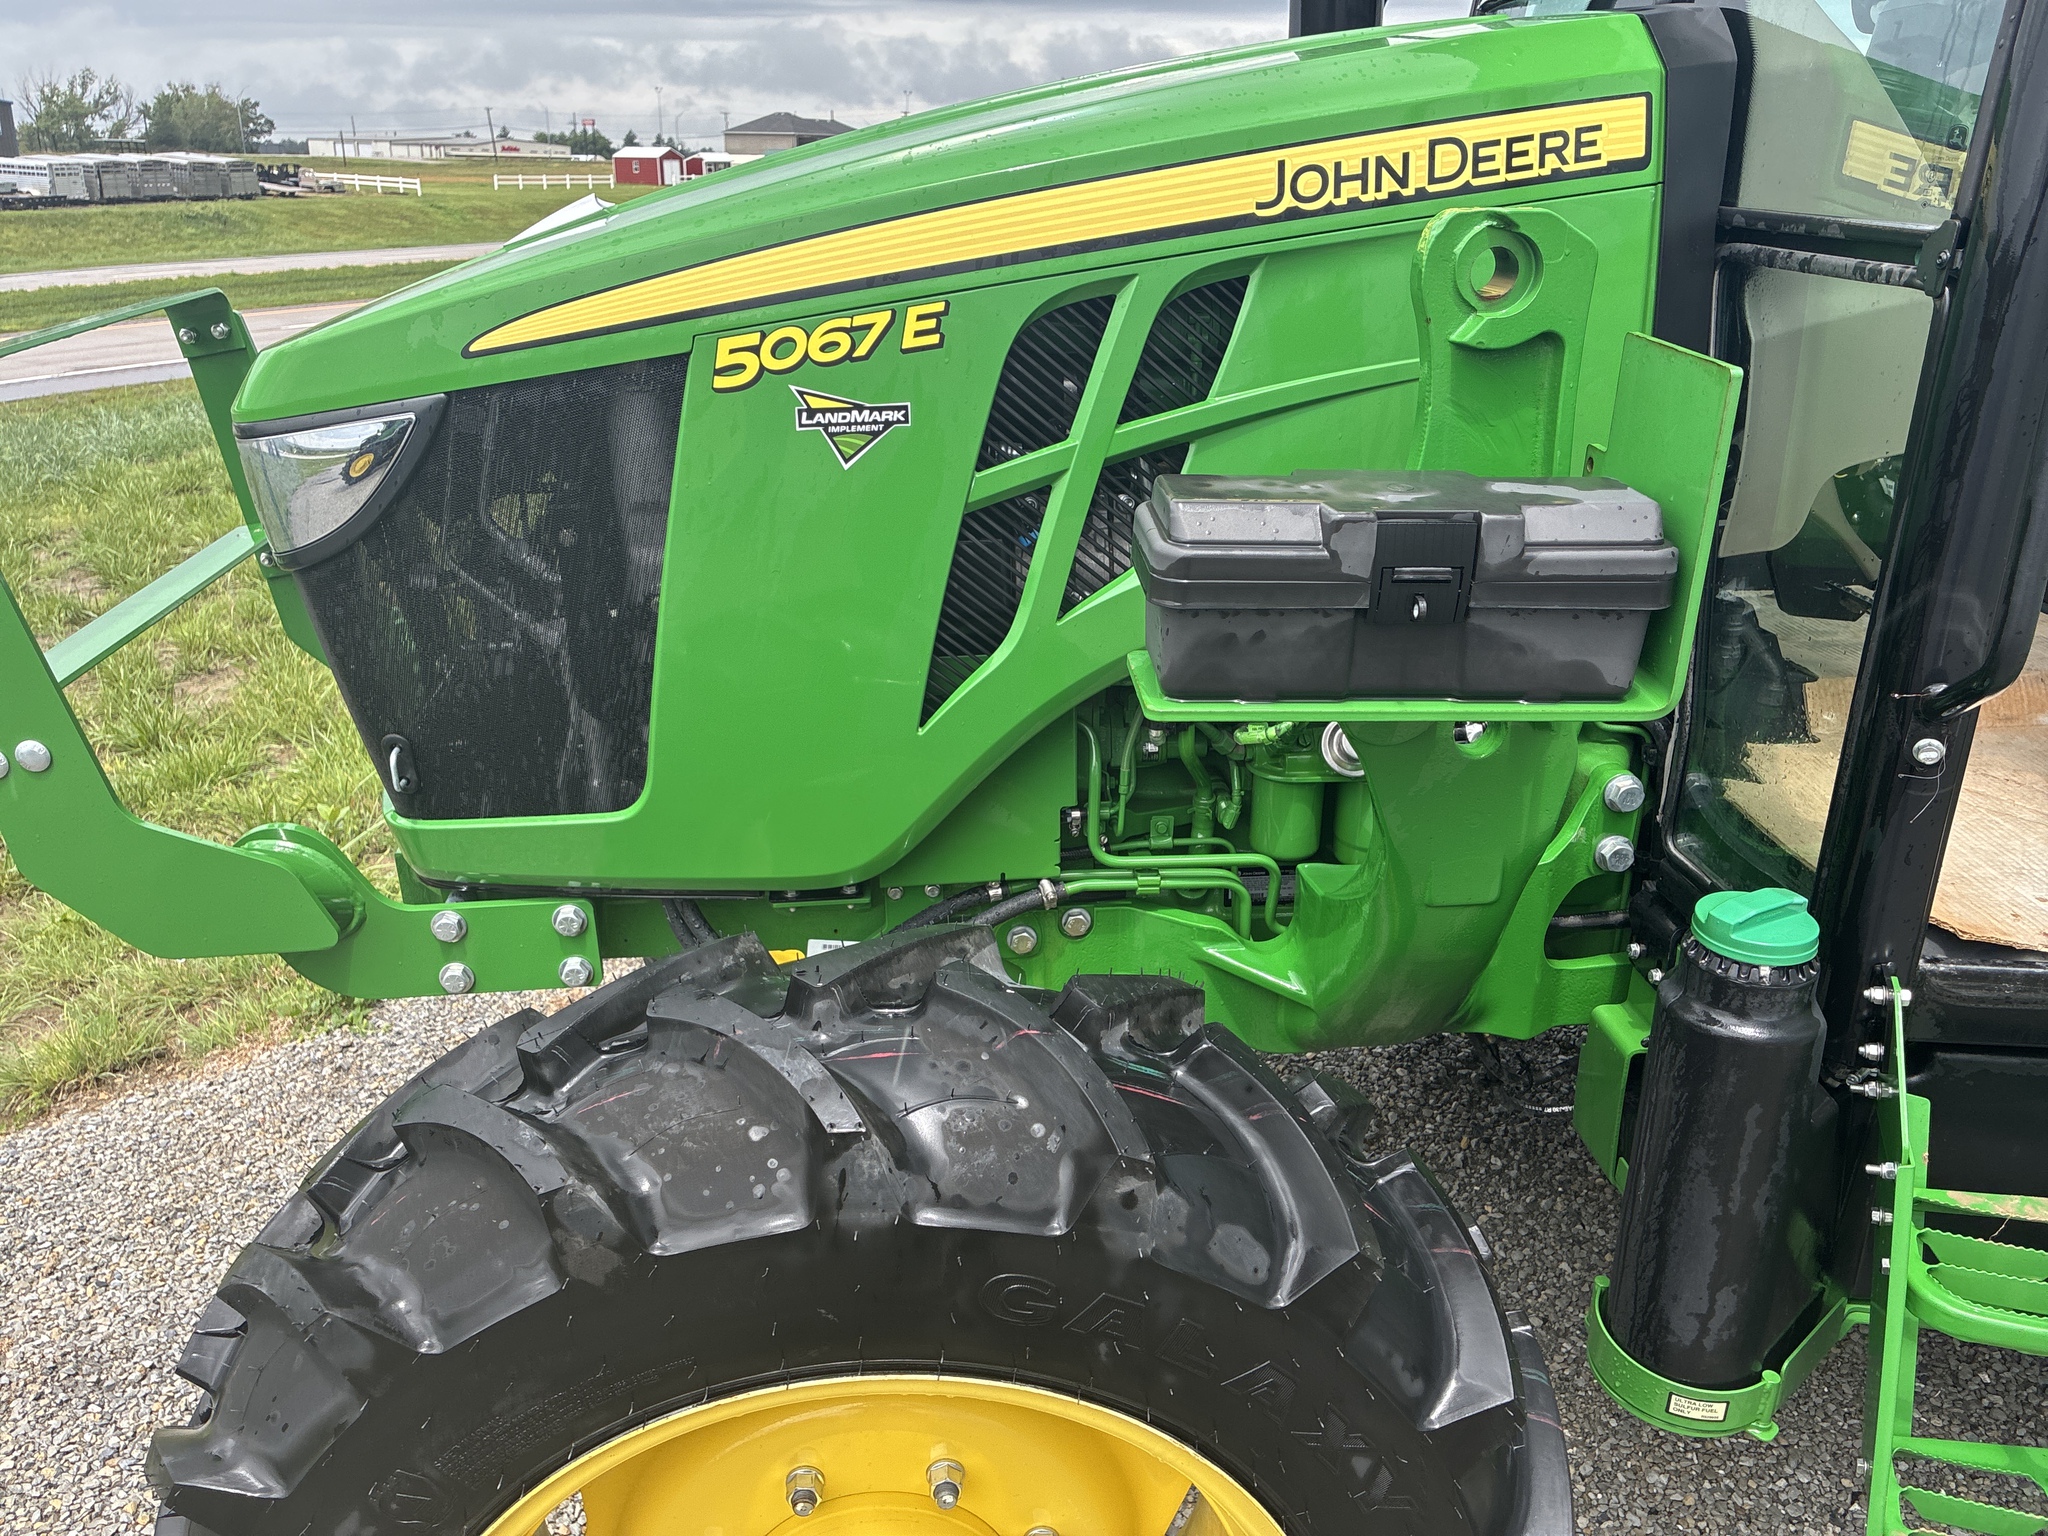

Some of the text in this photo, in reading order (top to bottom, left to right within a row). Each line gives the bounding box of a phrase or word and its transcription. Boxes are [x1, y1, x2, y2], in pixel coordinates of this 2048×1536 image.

[1255, 123, 1604, 210] JOHN DEERE
[712, 299, 951, 394] 5067 E
[801, 409, 906, 425] LANDMARK
[828, 423, 885, 434] IMPLEMENT
[979, 1272, 1421, 1514] GALAXY
[1673, 1402, 1700, 1411] SULFUR
[1674, 1397, 1696, 1406] ULTRA
[1672, 1406, 1691, 1415] ONLY
